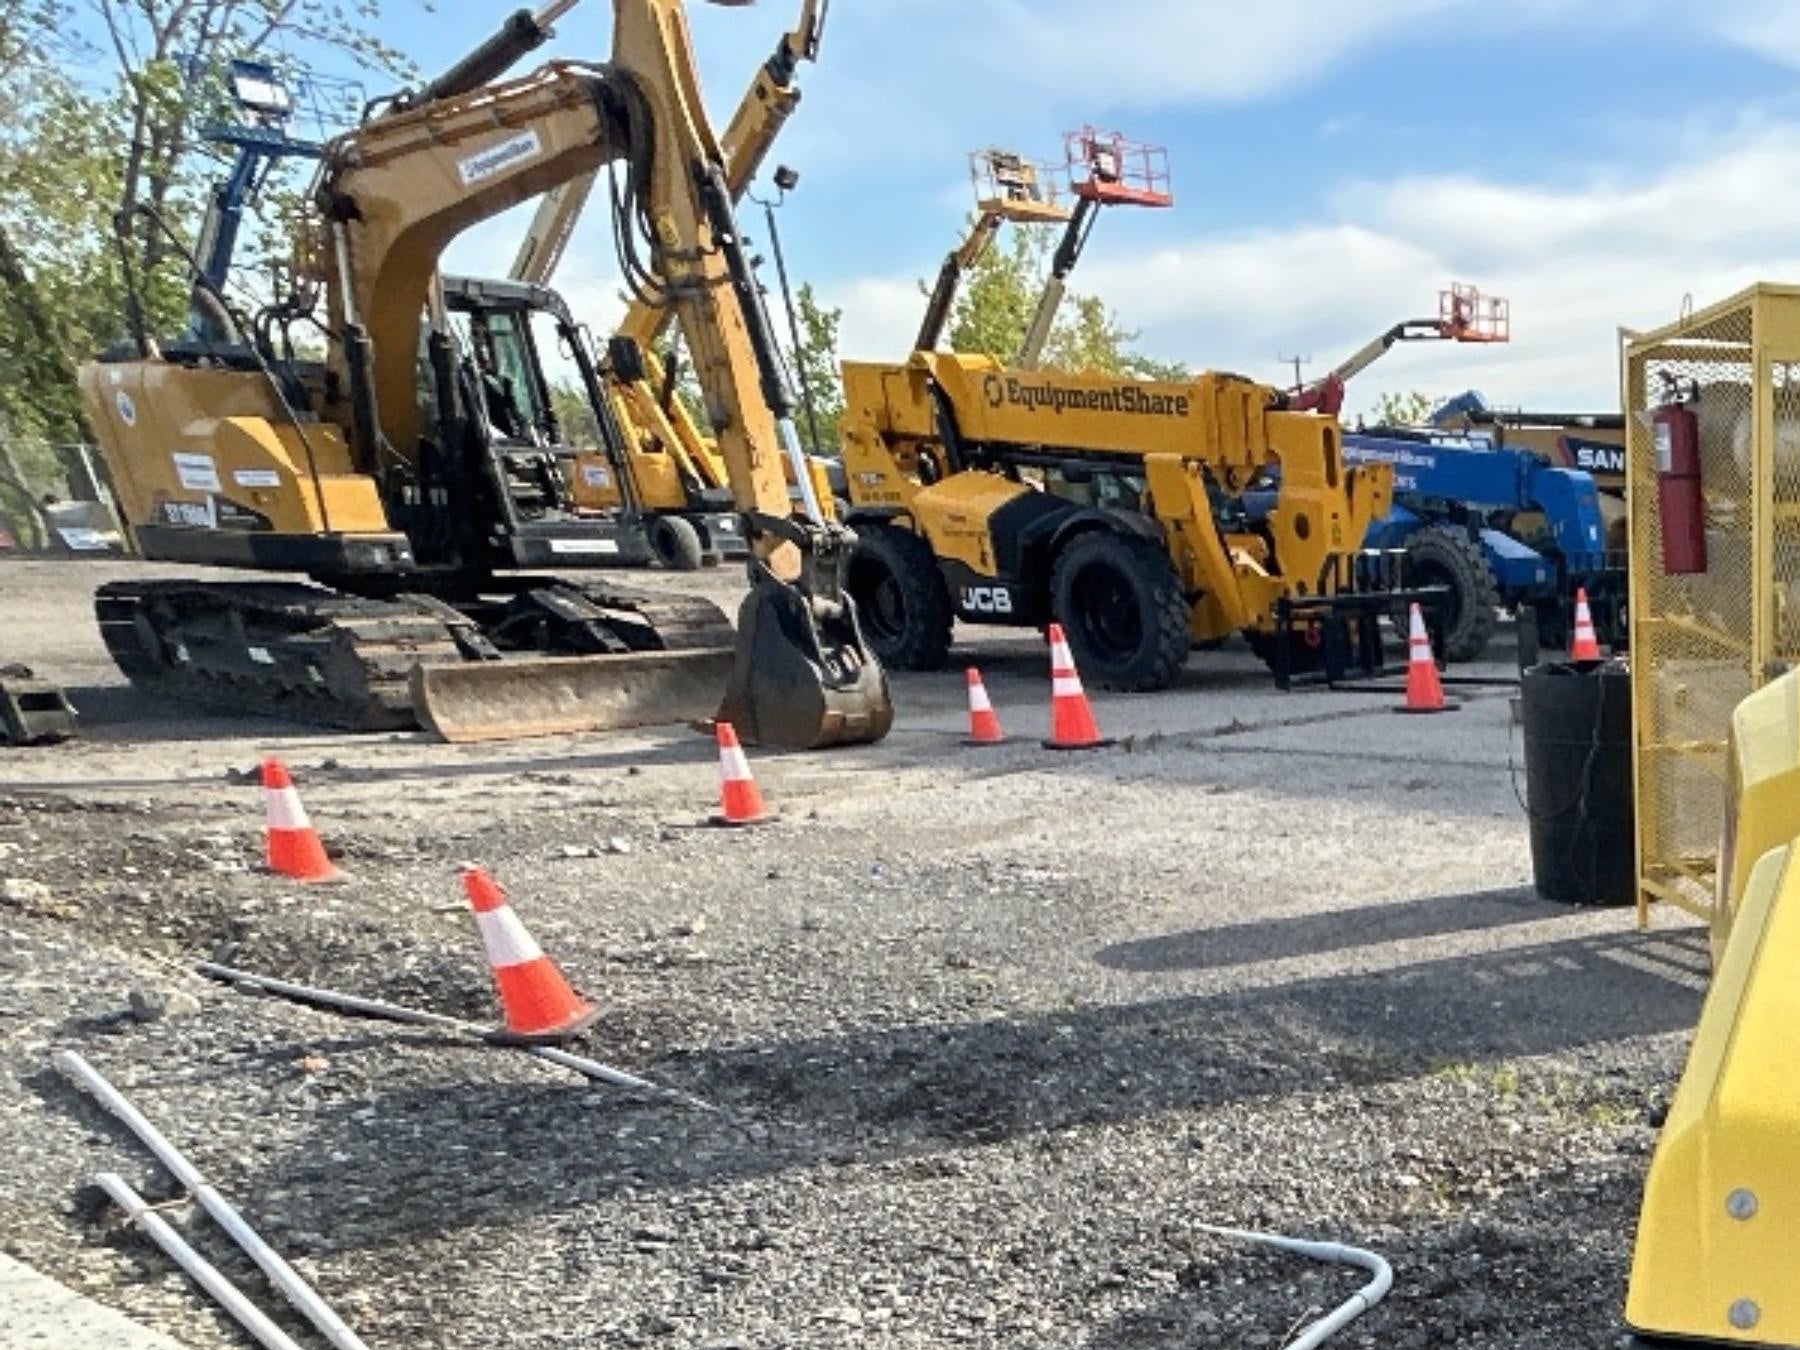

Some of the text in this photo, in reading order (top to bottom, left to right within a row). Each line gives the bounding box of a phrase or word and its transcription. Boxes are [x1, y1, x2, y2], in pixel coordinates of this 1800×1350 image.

[1006, 377, 1189, 416] EquipmentShare
[1577, 447, 1625, 472] SAN
[961, 586, 1013, 614] JCB
